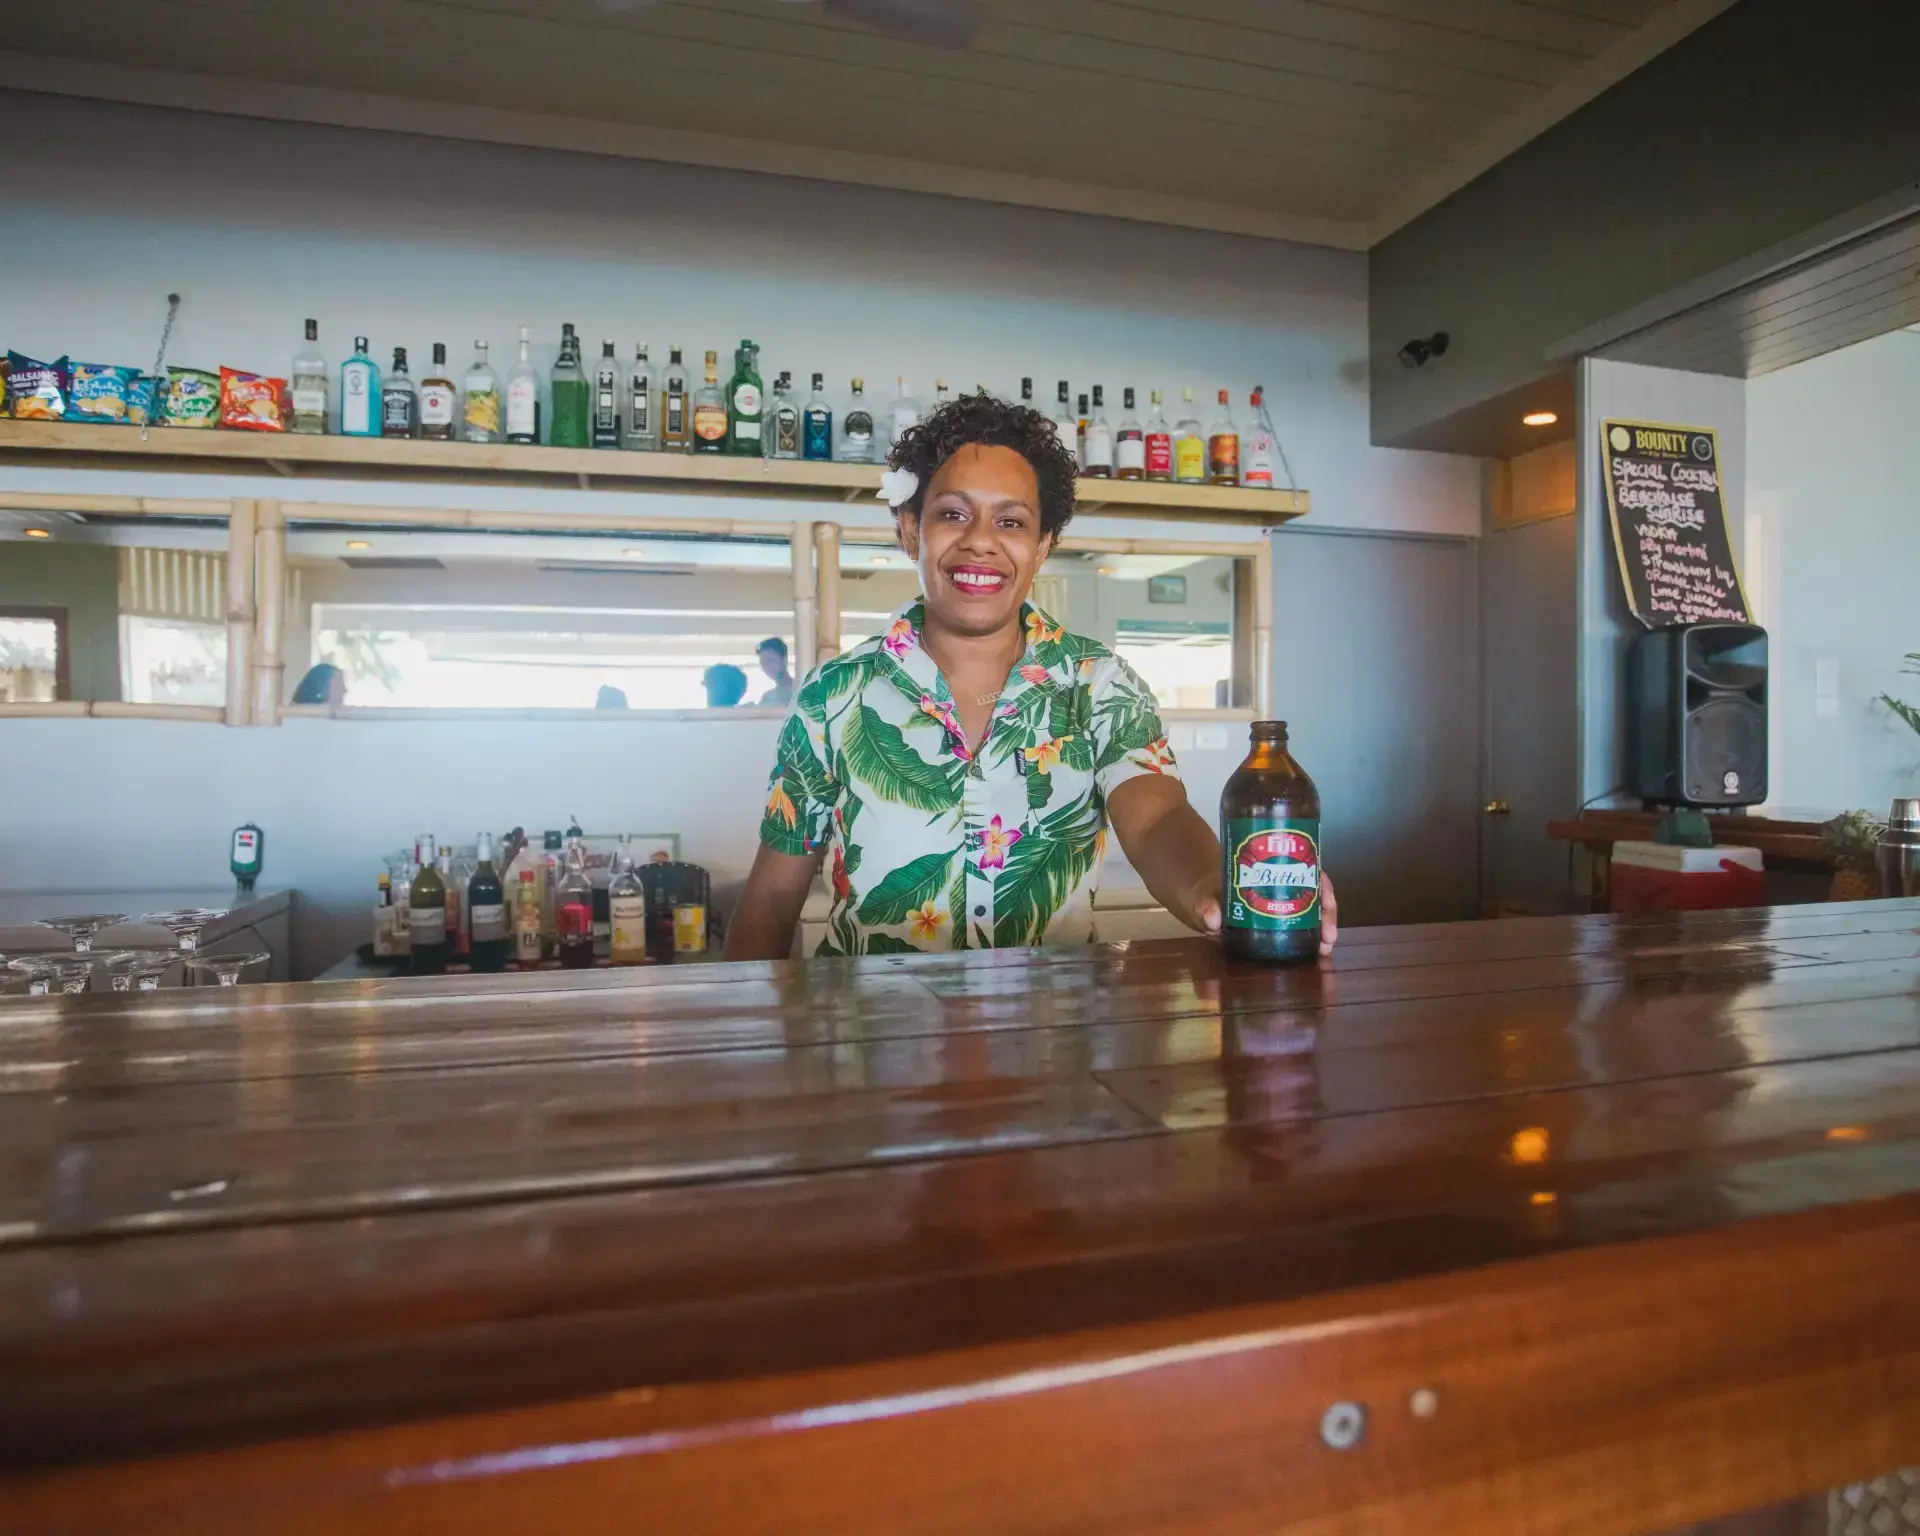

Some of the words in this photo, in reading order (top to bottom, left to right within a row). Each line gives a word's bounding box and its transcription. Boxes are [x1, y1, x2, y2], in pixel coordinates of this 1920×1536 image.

[1635, 430, 1687, 453] BOUNTY
[1251, 868, 1306, 885] Bitter
[1267, 901, 1296, 912] BEER
